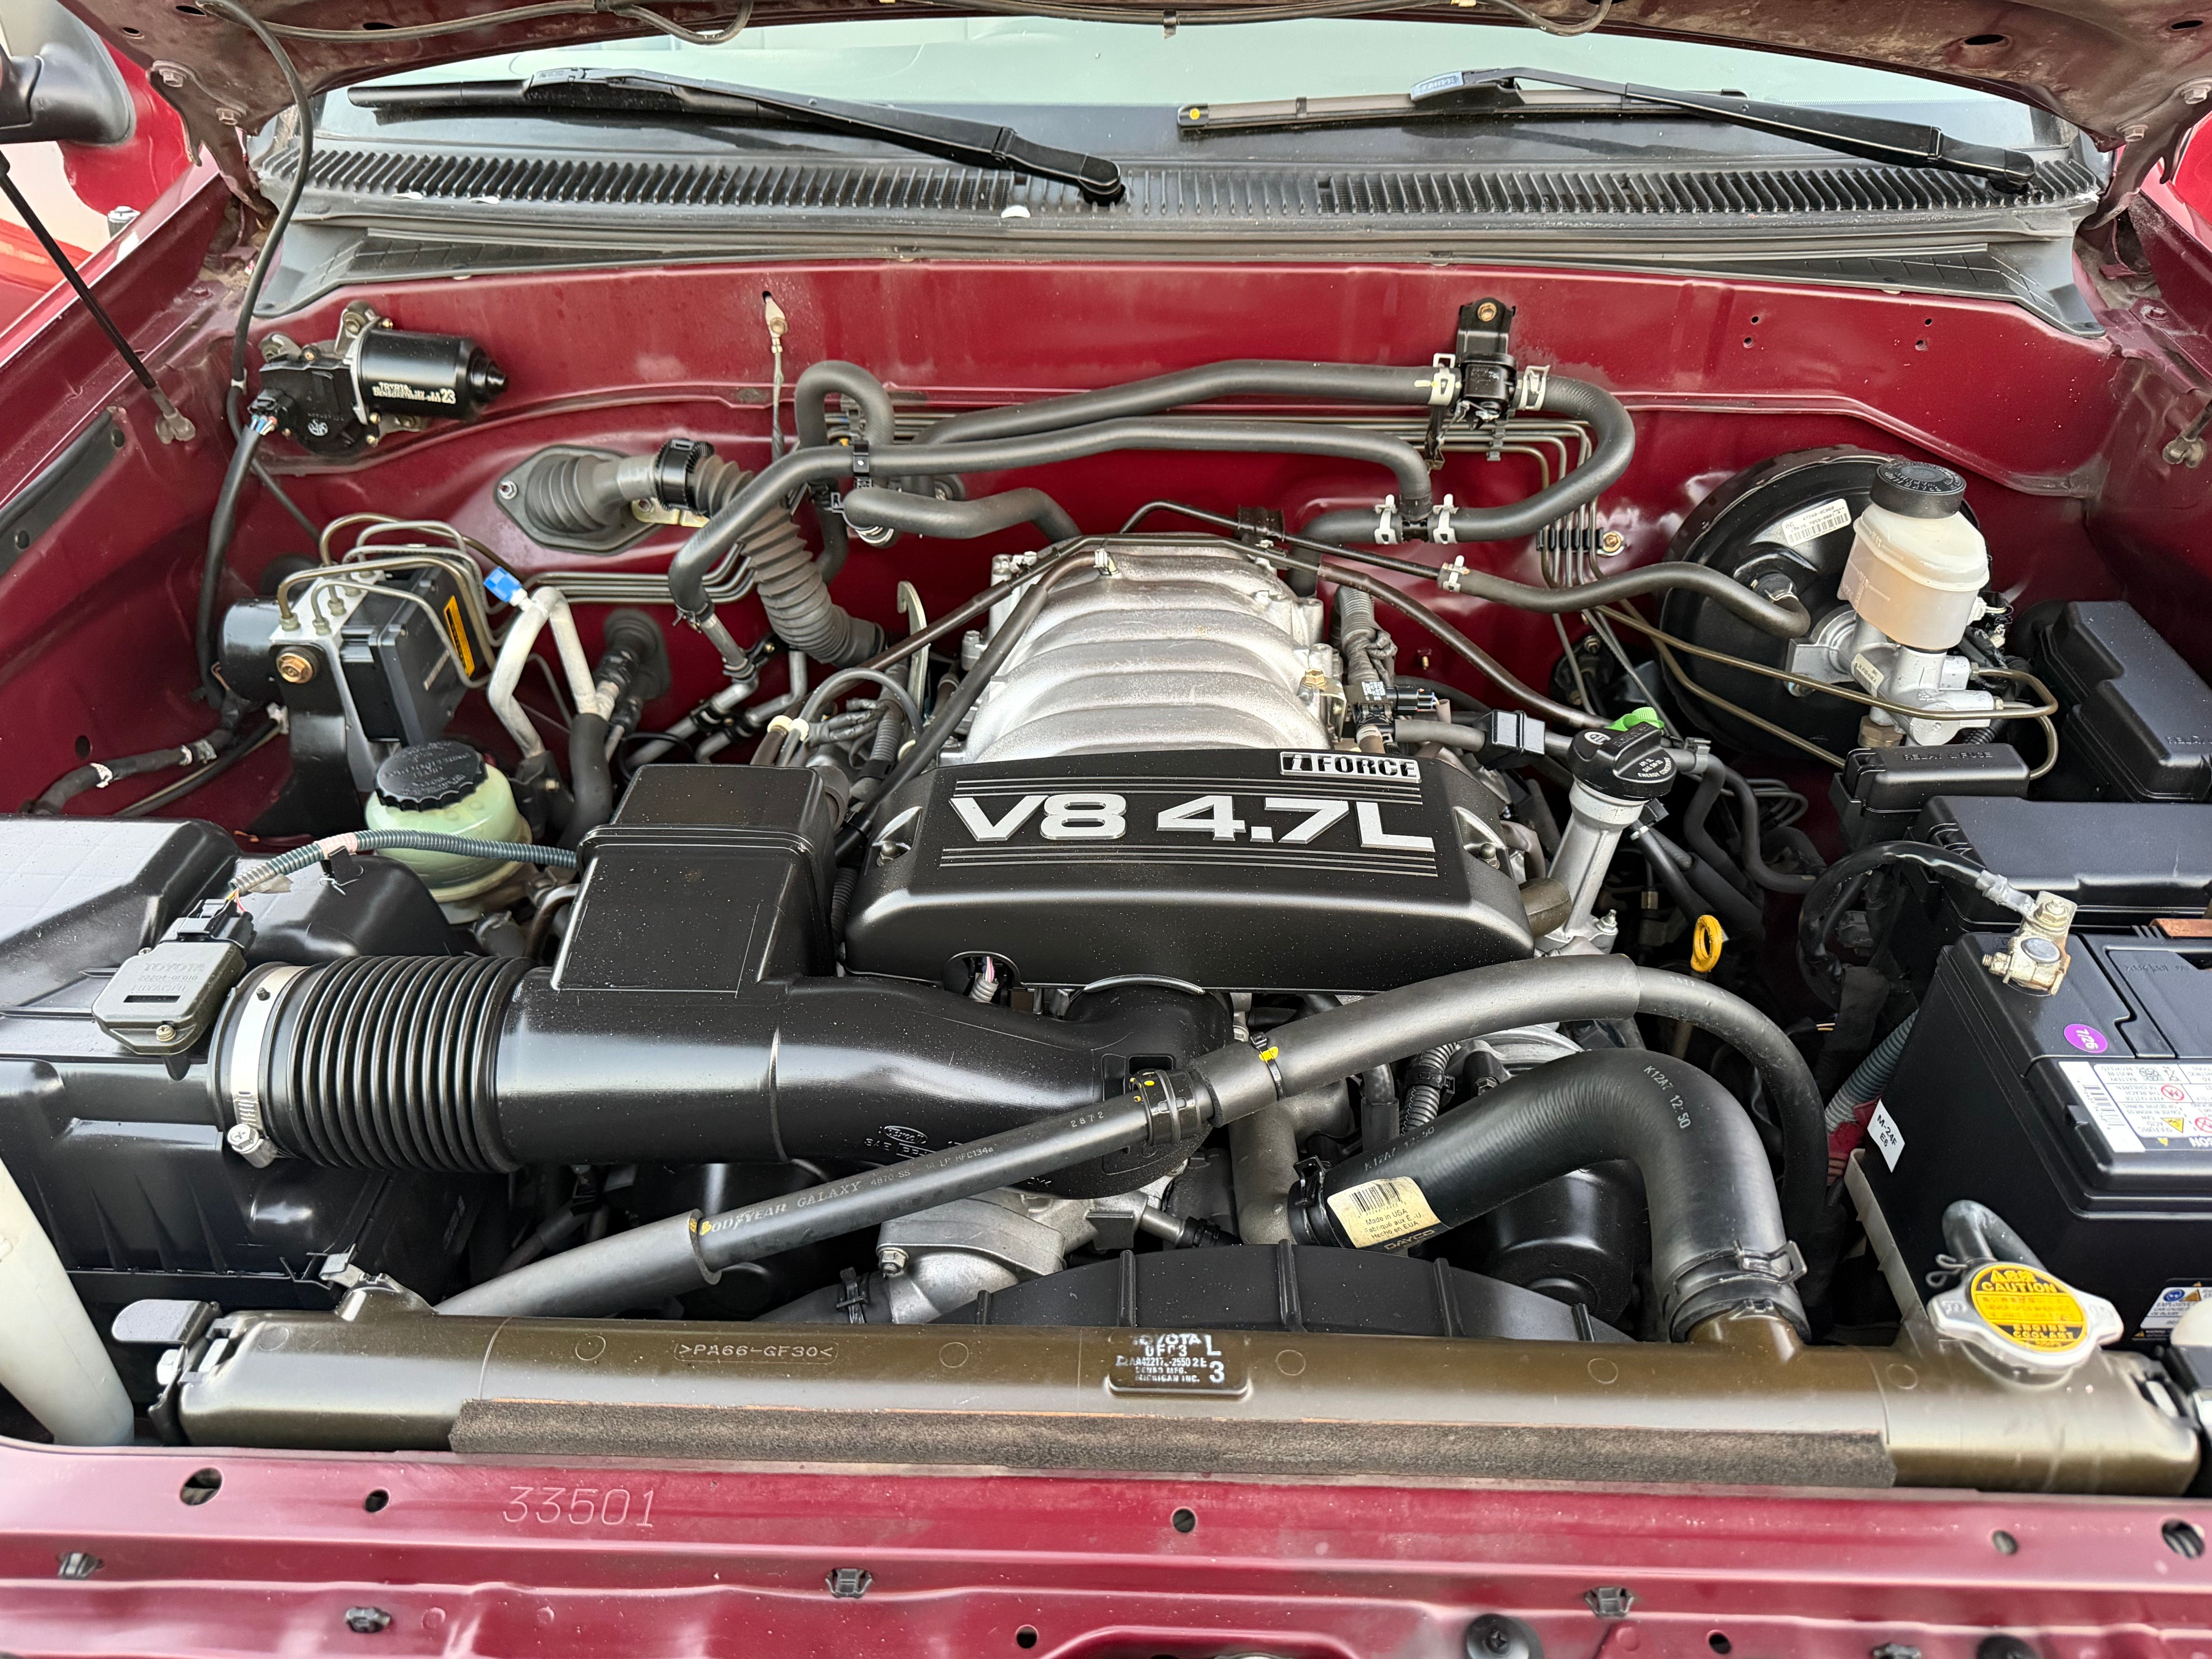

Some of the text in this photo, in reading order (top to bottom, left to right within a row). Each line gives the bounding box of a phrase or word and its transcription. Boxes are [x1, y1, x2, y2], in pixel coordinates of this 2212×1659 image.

[440, 388, 456, 404] 23
[1317, 755, 1417, 778] FORCE
[950, 794, 1436, 852] V8 4.7L
[144, 963, 205, 972] TOYOTA
[1644, 1066, 1691, 1128] K12A7 12:50
[1071, 1111, 1104, 1127] 2872
[1877, 1114, 1897, 1146] M-24F
[797, 1181, 862, 1207] GALAXY
[955, 1146, 994, 1161] HFC134a
[1365, 1216, 1383, 1226] Made
[1393, 1208, 1408, 1218] USA
[1365, 1221, 1393, 1235] Fabriqué
[1394, 1218, 1405, 1226] aux
[1371, 1229, 1393, 1239] Hecho
[1404, 1221, 1420, 1230] EUA
[1384, 1229, 1435, 1250] DAYCO
[1981, 1281, 2057, 1293] CAUTION
[1132, 1333, 1202, 1345] OYOTA
[2013, 1331, 2075, 1340] COOLANT
[503, 1486, 656, 1527] 33501
